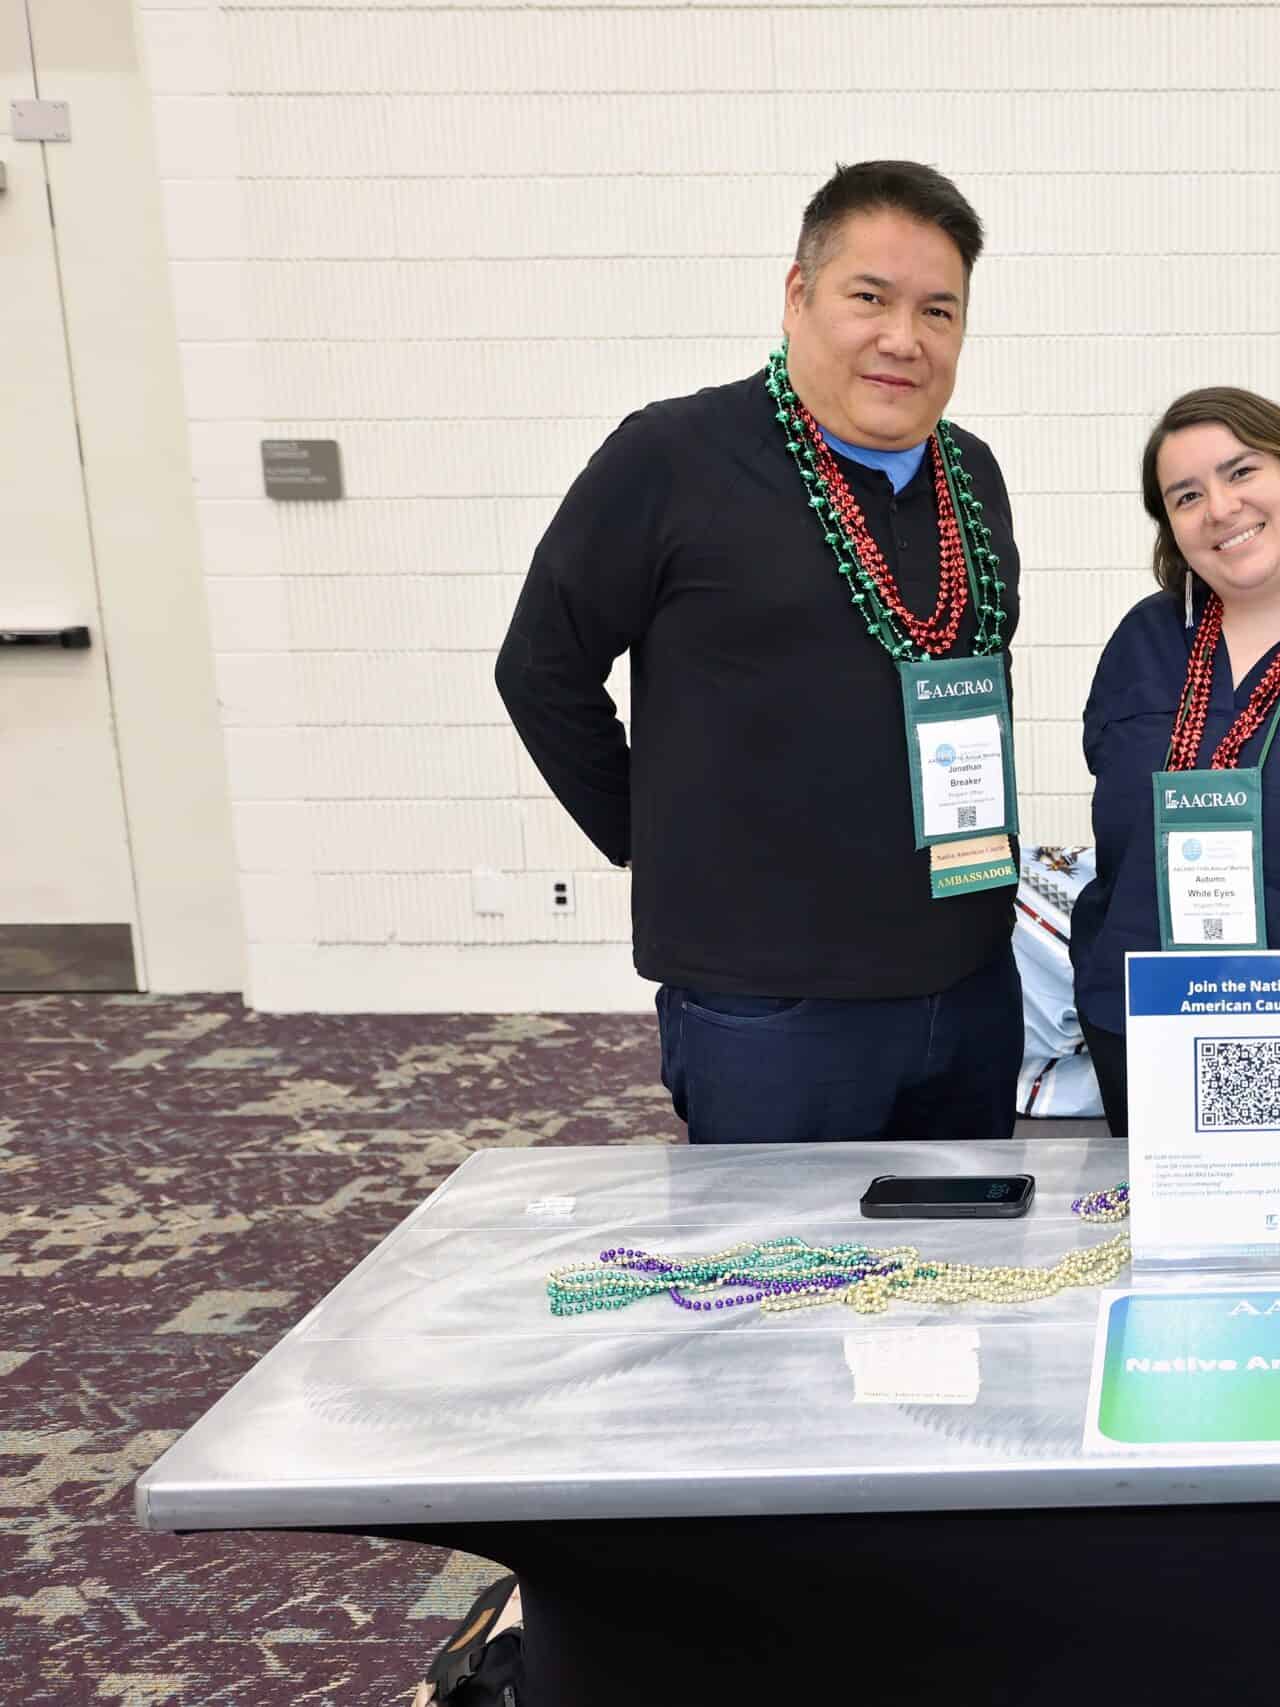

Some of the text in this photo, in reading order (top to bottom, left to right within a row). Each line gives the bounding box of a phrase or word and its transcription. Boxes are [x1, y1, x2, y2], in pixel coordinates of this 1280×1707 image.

[931, 678, 994, 698] AACRAO
[950, 776, 982, 788] Breaker
[1178, 791, 1248, 809] AACRAO
[937, 865, 1014, 889] AMBASSADOR
[1187, 888, 1236, 900] White Eyes
[1187, 979, 1218, 996] Join
[1222, 978, 1246, 993] the
[1180, 999, 1252, 1013] American
[1125, 1355, 1238, 1373] Native
